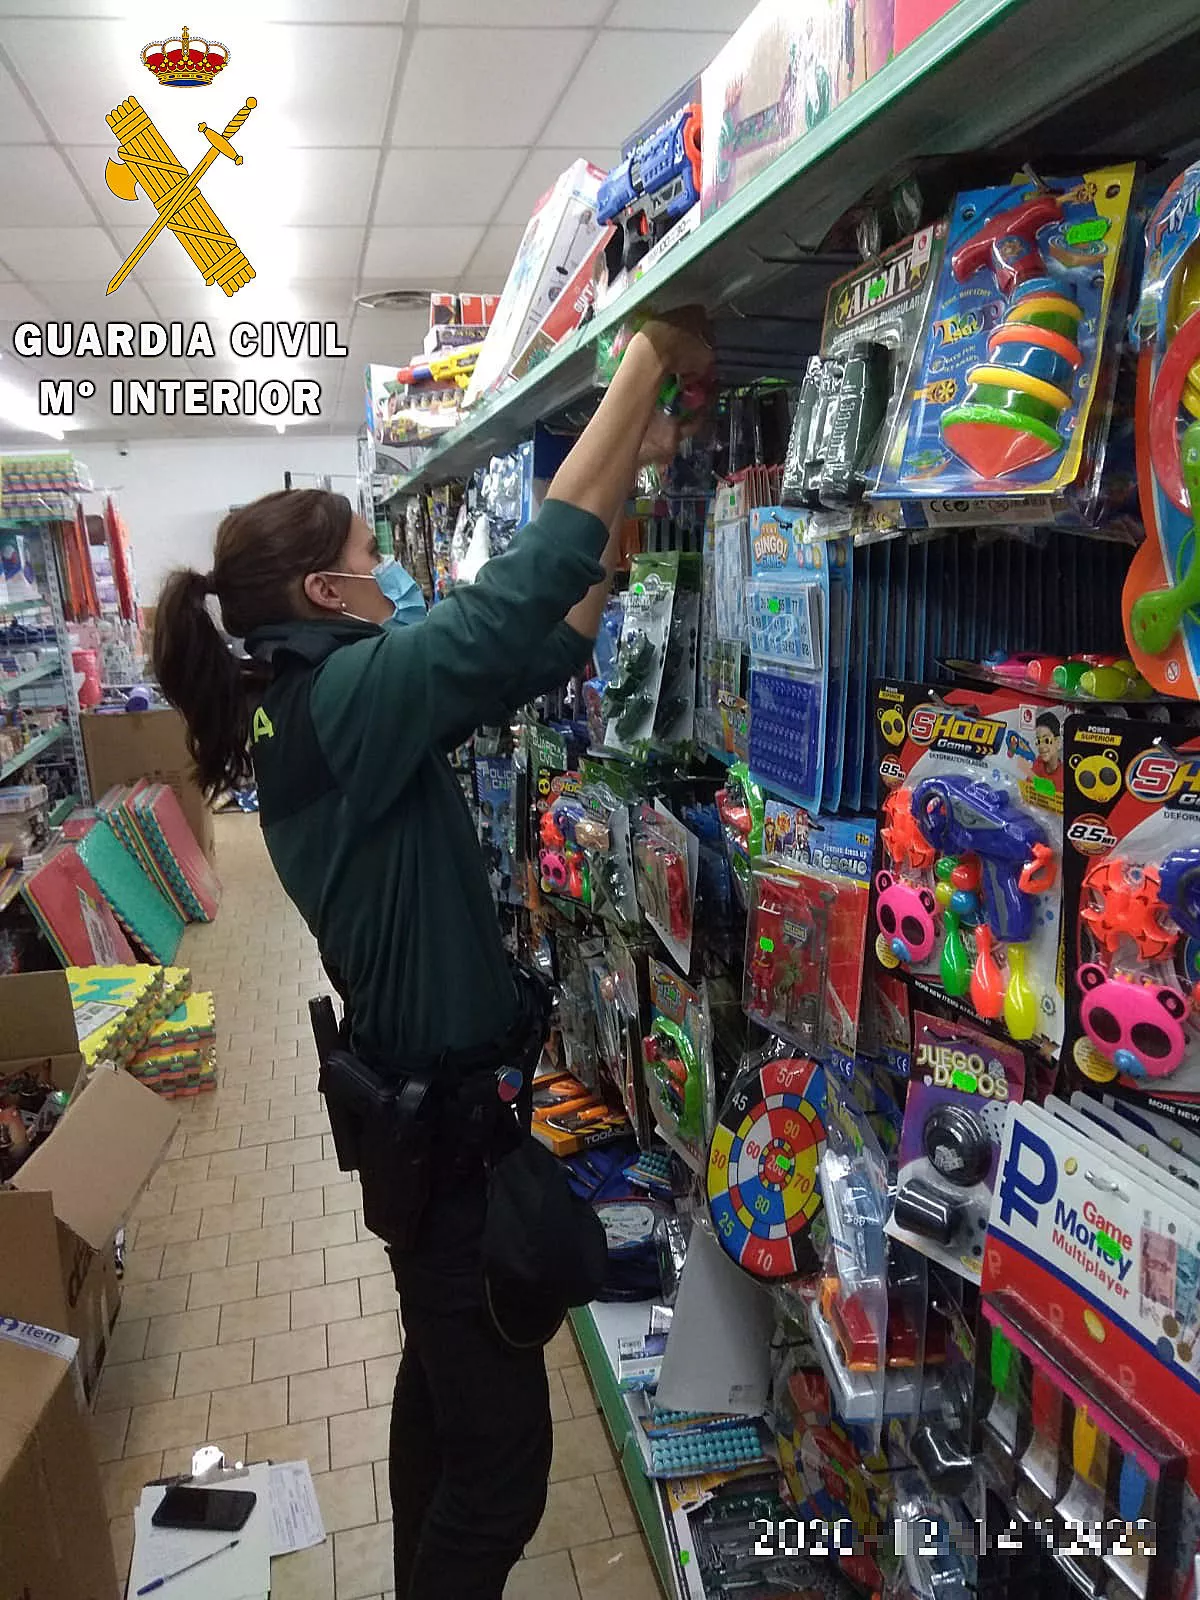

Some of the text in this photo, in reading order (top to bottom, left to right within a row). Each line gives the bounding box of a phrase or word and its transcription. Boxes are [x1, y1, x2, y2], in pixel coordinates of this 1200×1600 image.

[754, 535, 788, 559] BINGO!
[252, 706, 275, 743] A
[911, 710, 1008, 746] SHOOT
[937, 738, 972, 752] Game
[1080, 731, 1116, 744] SUPERIOR
[812, 849, 868, 876] Rescue
[916, 1044, 985, 1076] JUEGO
[776, 1066, 794, 1089] 50
[934, 1064, 1009, 1101] DOS
[731, 1092, 747, 1111] 45
[1148, 1098, 1176, 1114] MORE
[783, 1119, 800, 1139] 90
[711, 1149, 726, 1169] 30
[746, 1140, 760, 1161] 60
[792, 1173, 810, 1194] 70
[754, 1194, 770, 1215] 80
[718, 1211, 736, 1237] 25
[1083, 1200, 1133, 1251] Game
[756, 1248, 773, 1272] 10
[1052, 1228, 1130, 1299] Multiplayer
